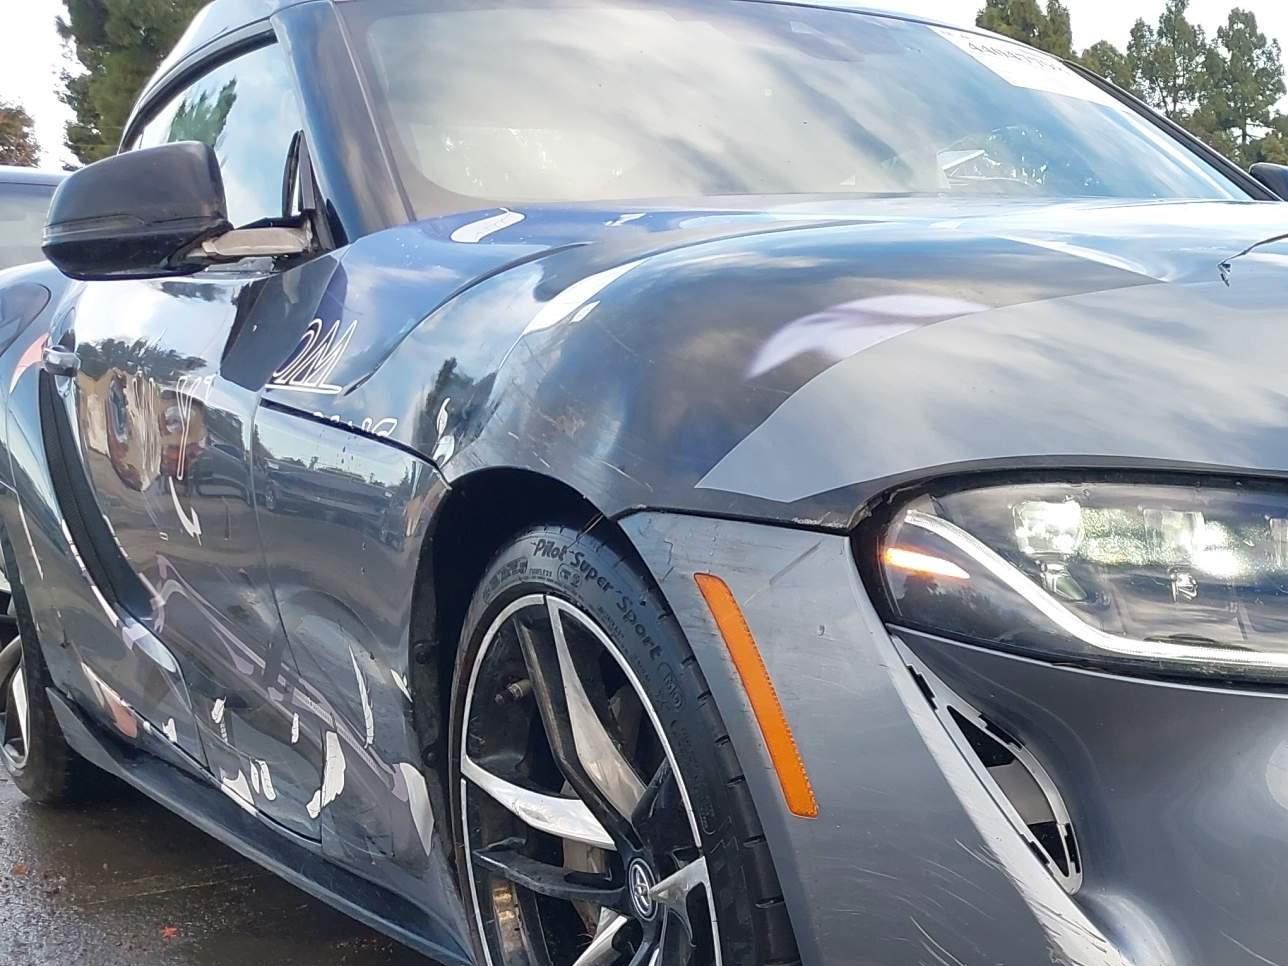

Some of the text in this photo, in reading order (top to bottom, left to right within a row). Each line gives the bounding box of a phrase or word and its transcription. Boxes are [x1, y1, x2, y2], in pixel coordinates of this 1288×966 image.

[533, 538, 567, 562] Pilot
[570, 551, 614, 593] Super
[615, 595, 663, 660] Sport
